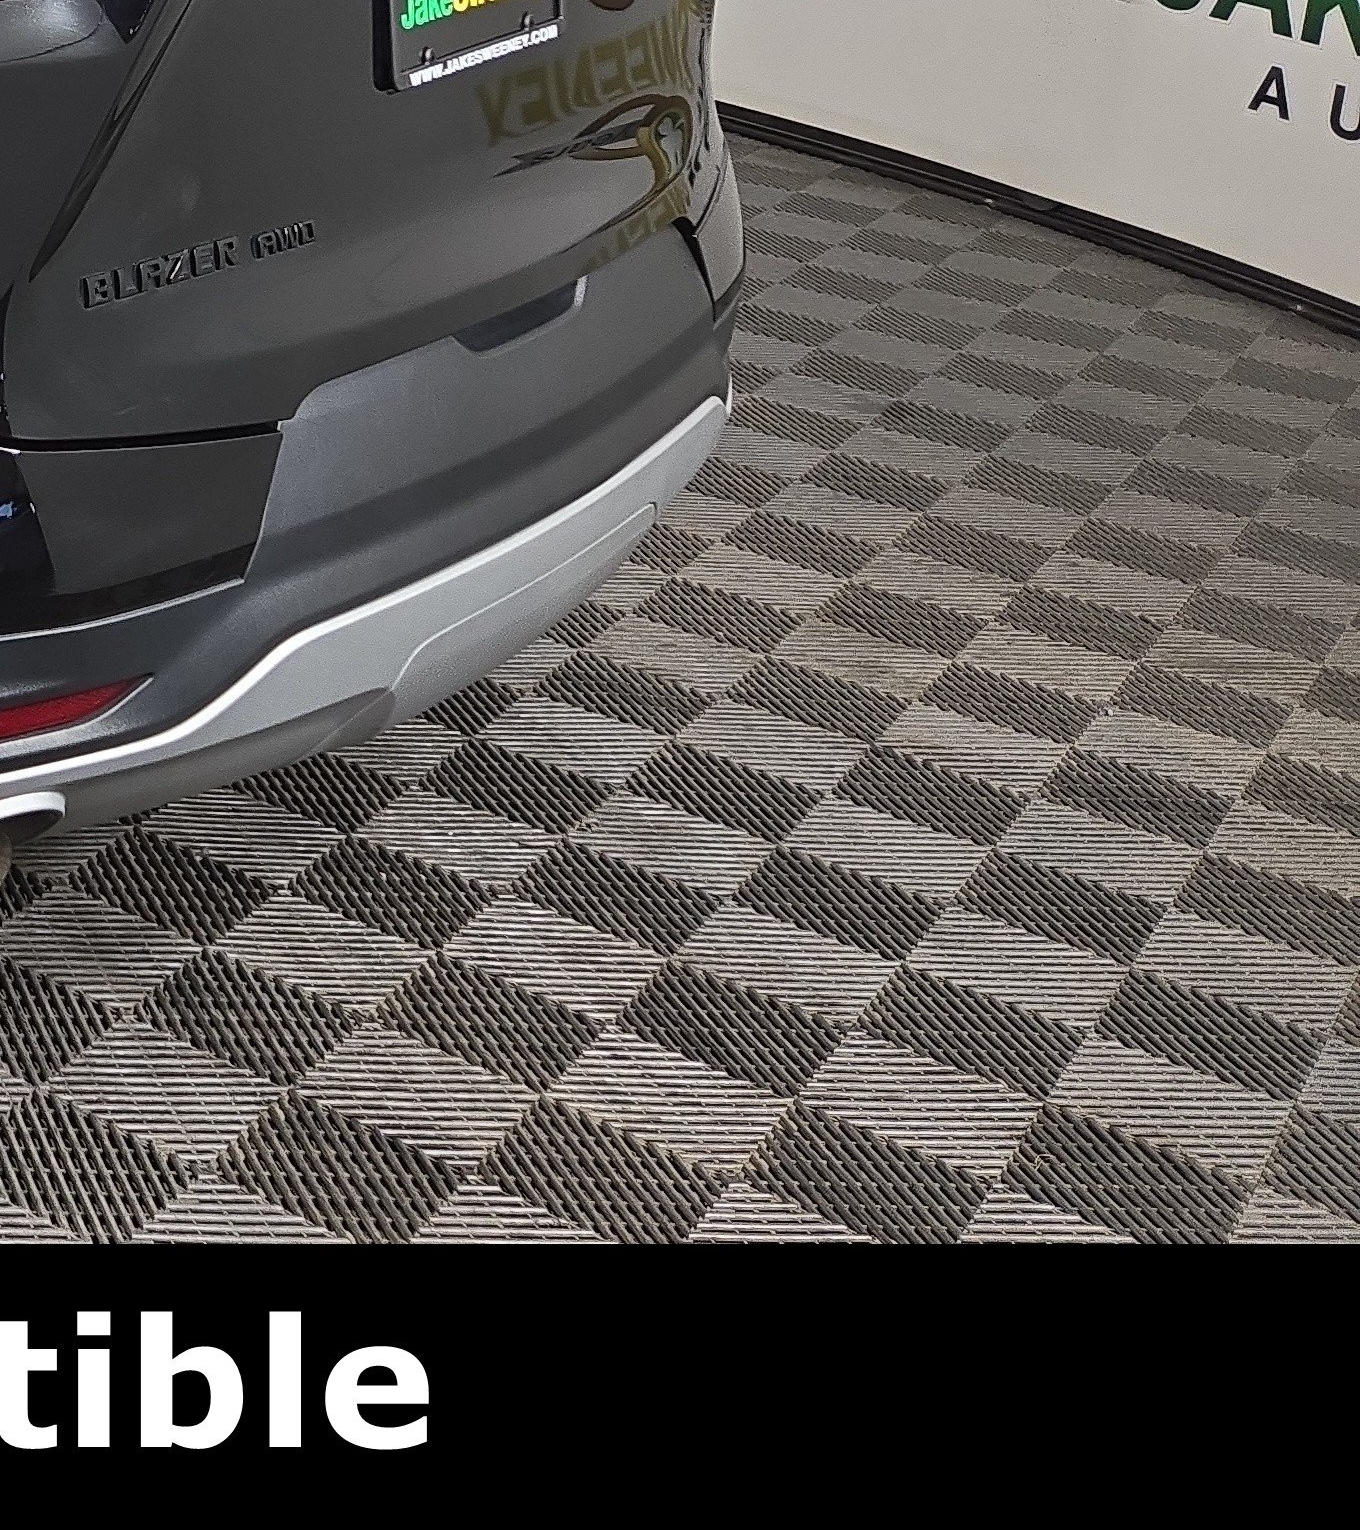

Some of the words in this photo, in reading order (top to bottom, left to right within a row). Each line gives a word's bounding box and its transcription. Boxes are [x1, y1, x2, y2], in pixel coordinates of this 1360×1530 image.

[409, 24, 559, 87] WWW.JAKESWEENEY.COM
[81, 235, 240, 310] BLAZER
[249, 220, 317, 260] AWD
